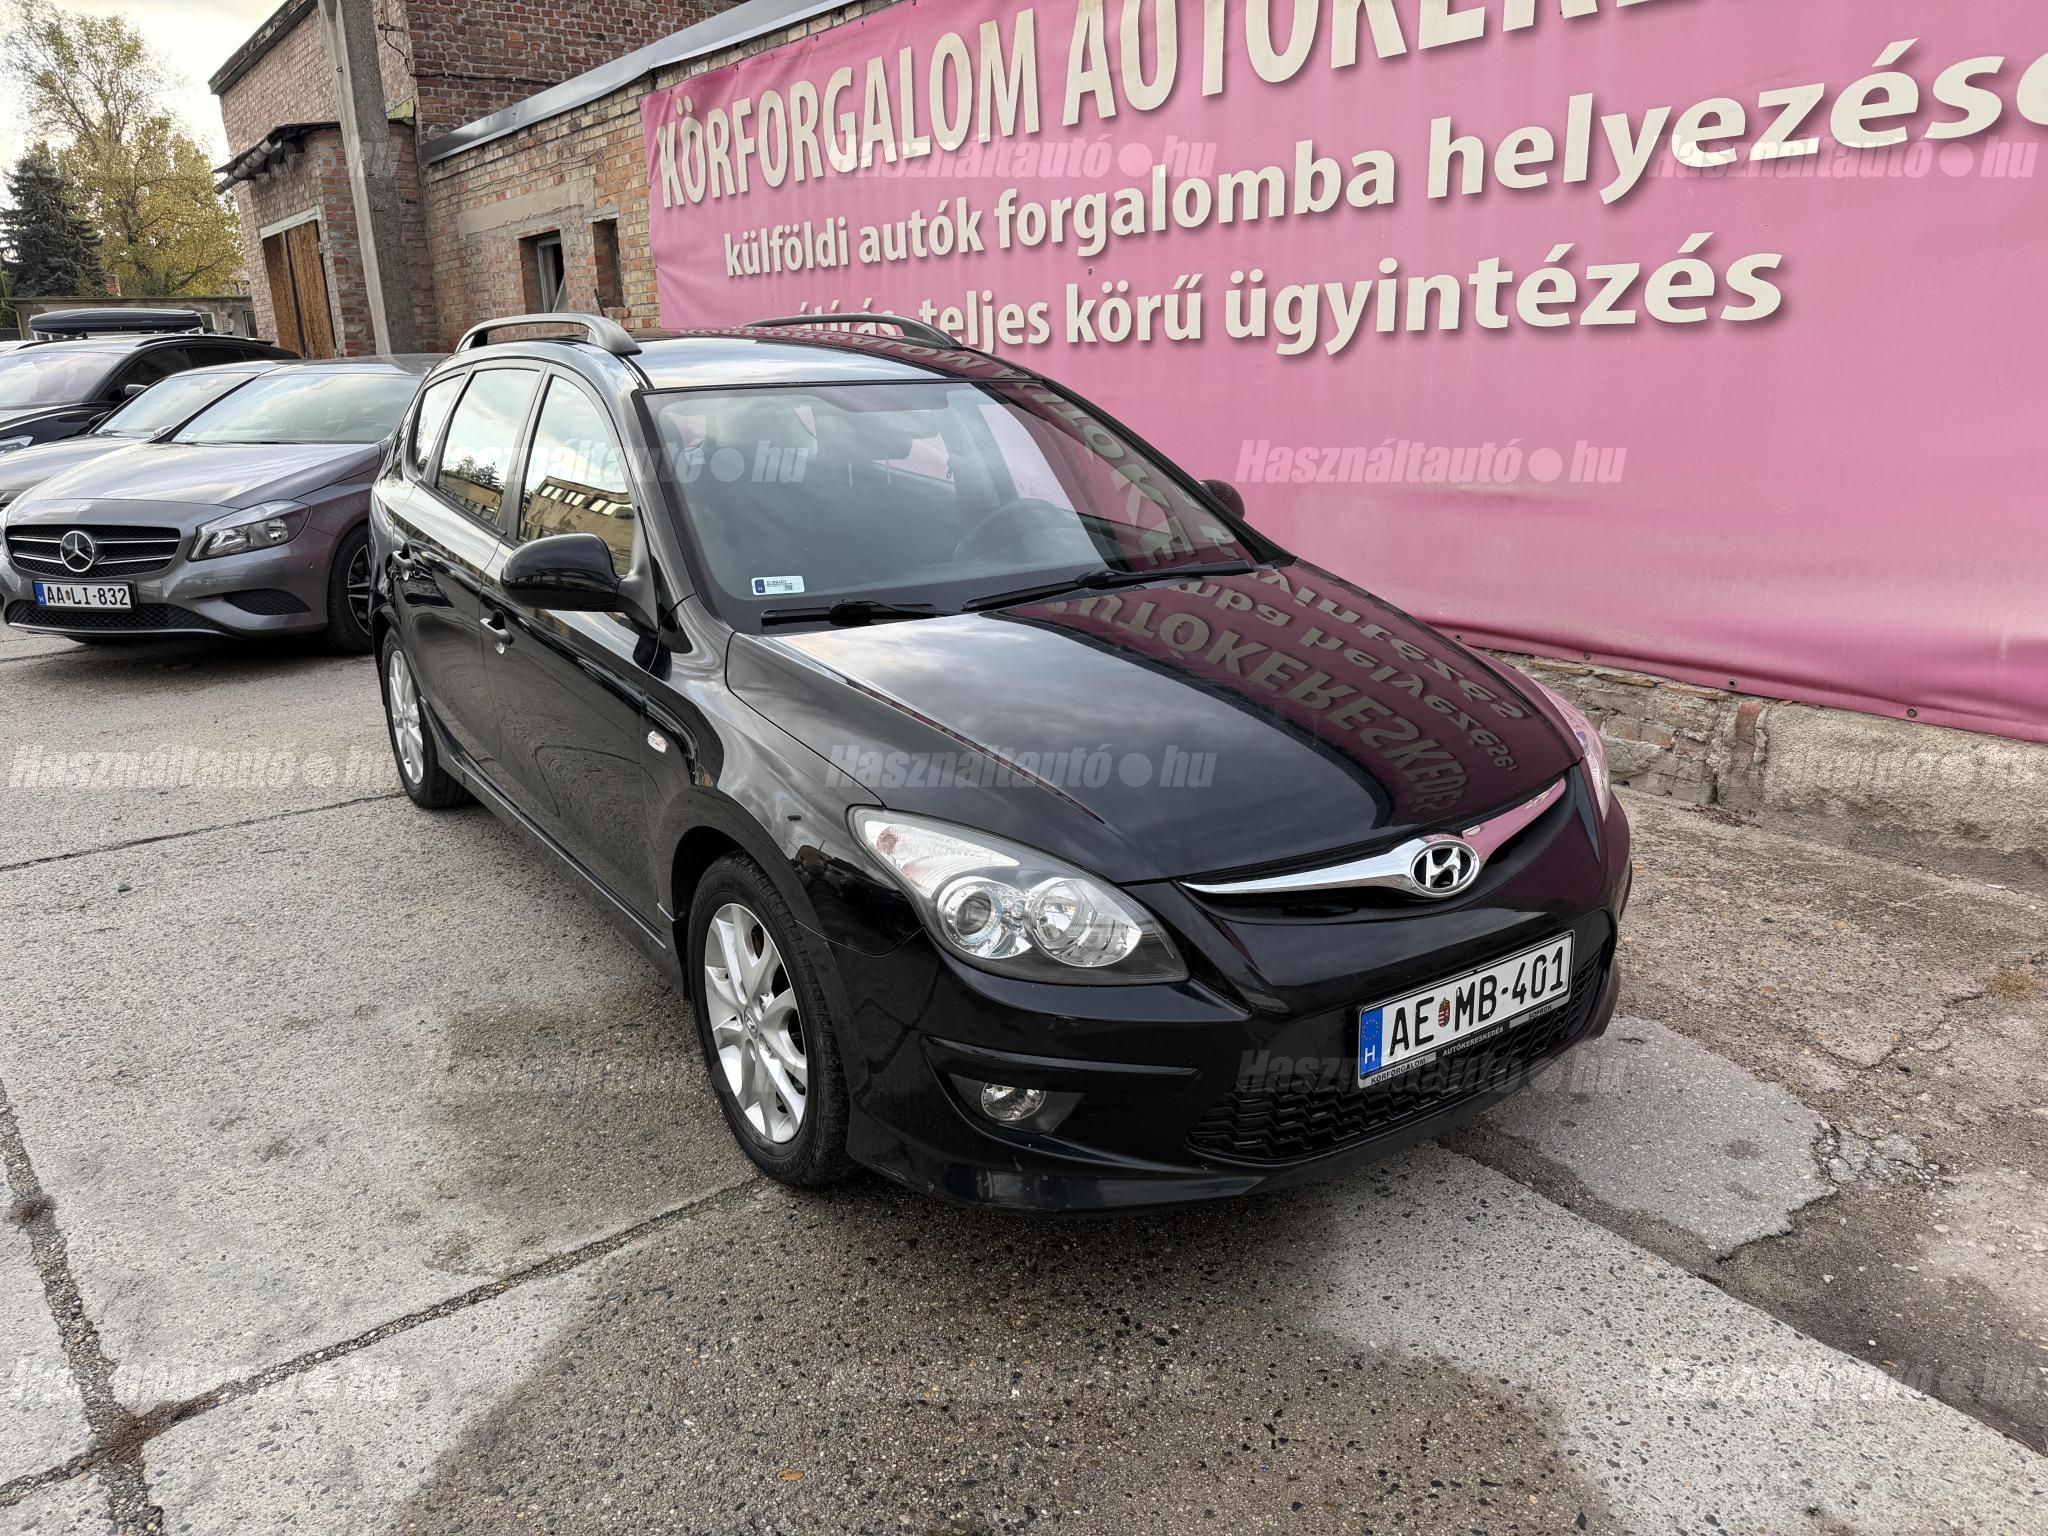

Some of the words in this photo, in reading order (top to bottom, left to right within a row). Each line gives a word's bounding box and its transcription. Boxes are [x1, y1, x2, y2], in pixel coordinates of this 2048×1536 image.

[657, 8, 1039, 209] KÖRFORGALOM
[725, 216, 849, 277] külföldi
[858, 197, 985, 265] autók
[995, 140, 1394, 256] forgalomba
[918, 289, 1050, 355] teljes
[1066, 273, 1200, 346] körű
[1225, 232, 1783, 356] ügyintézés
